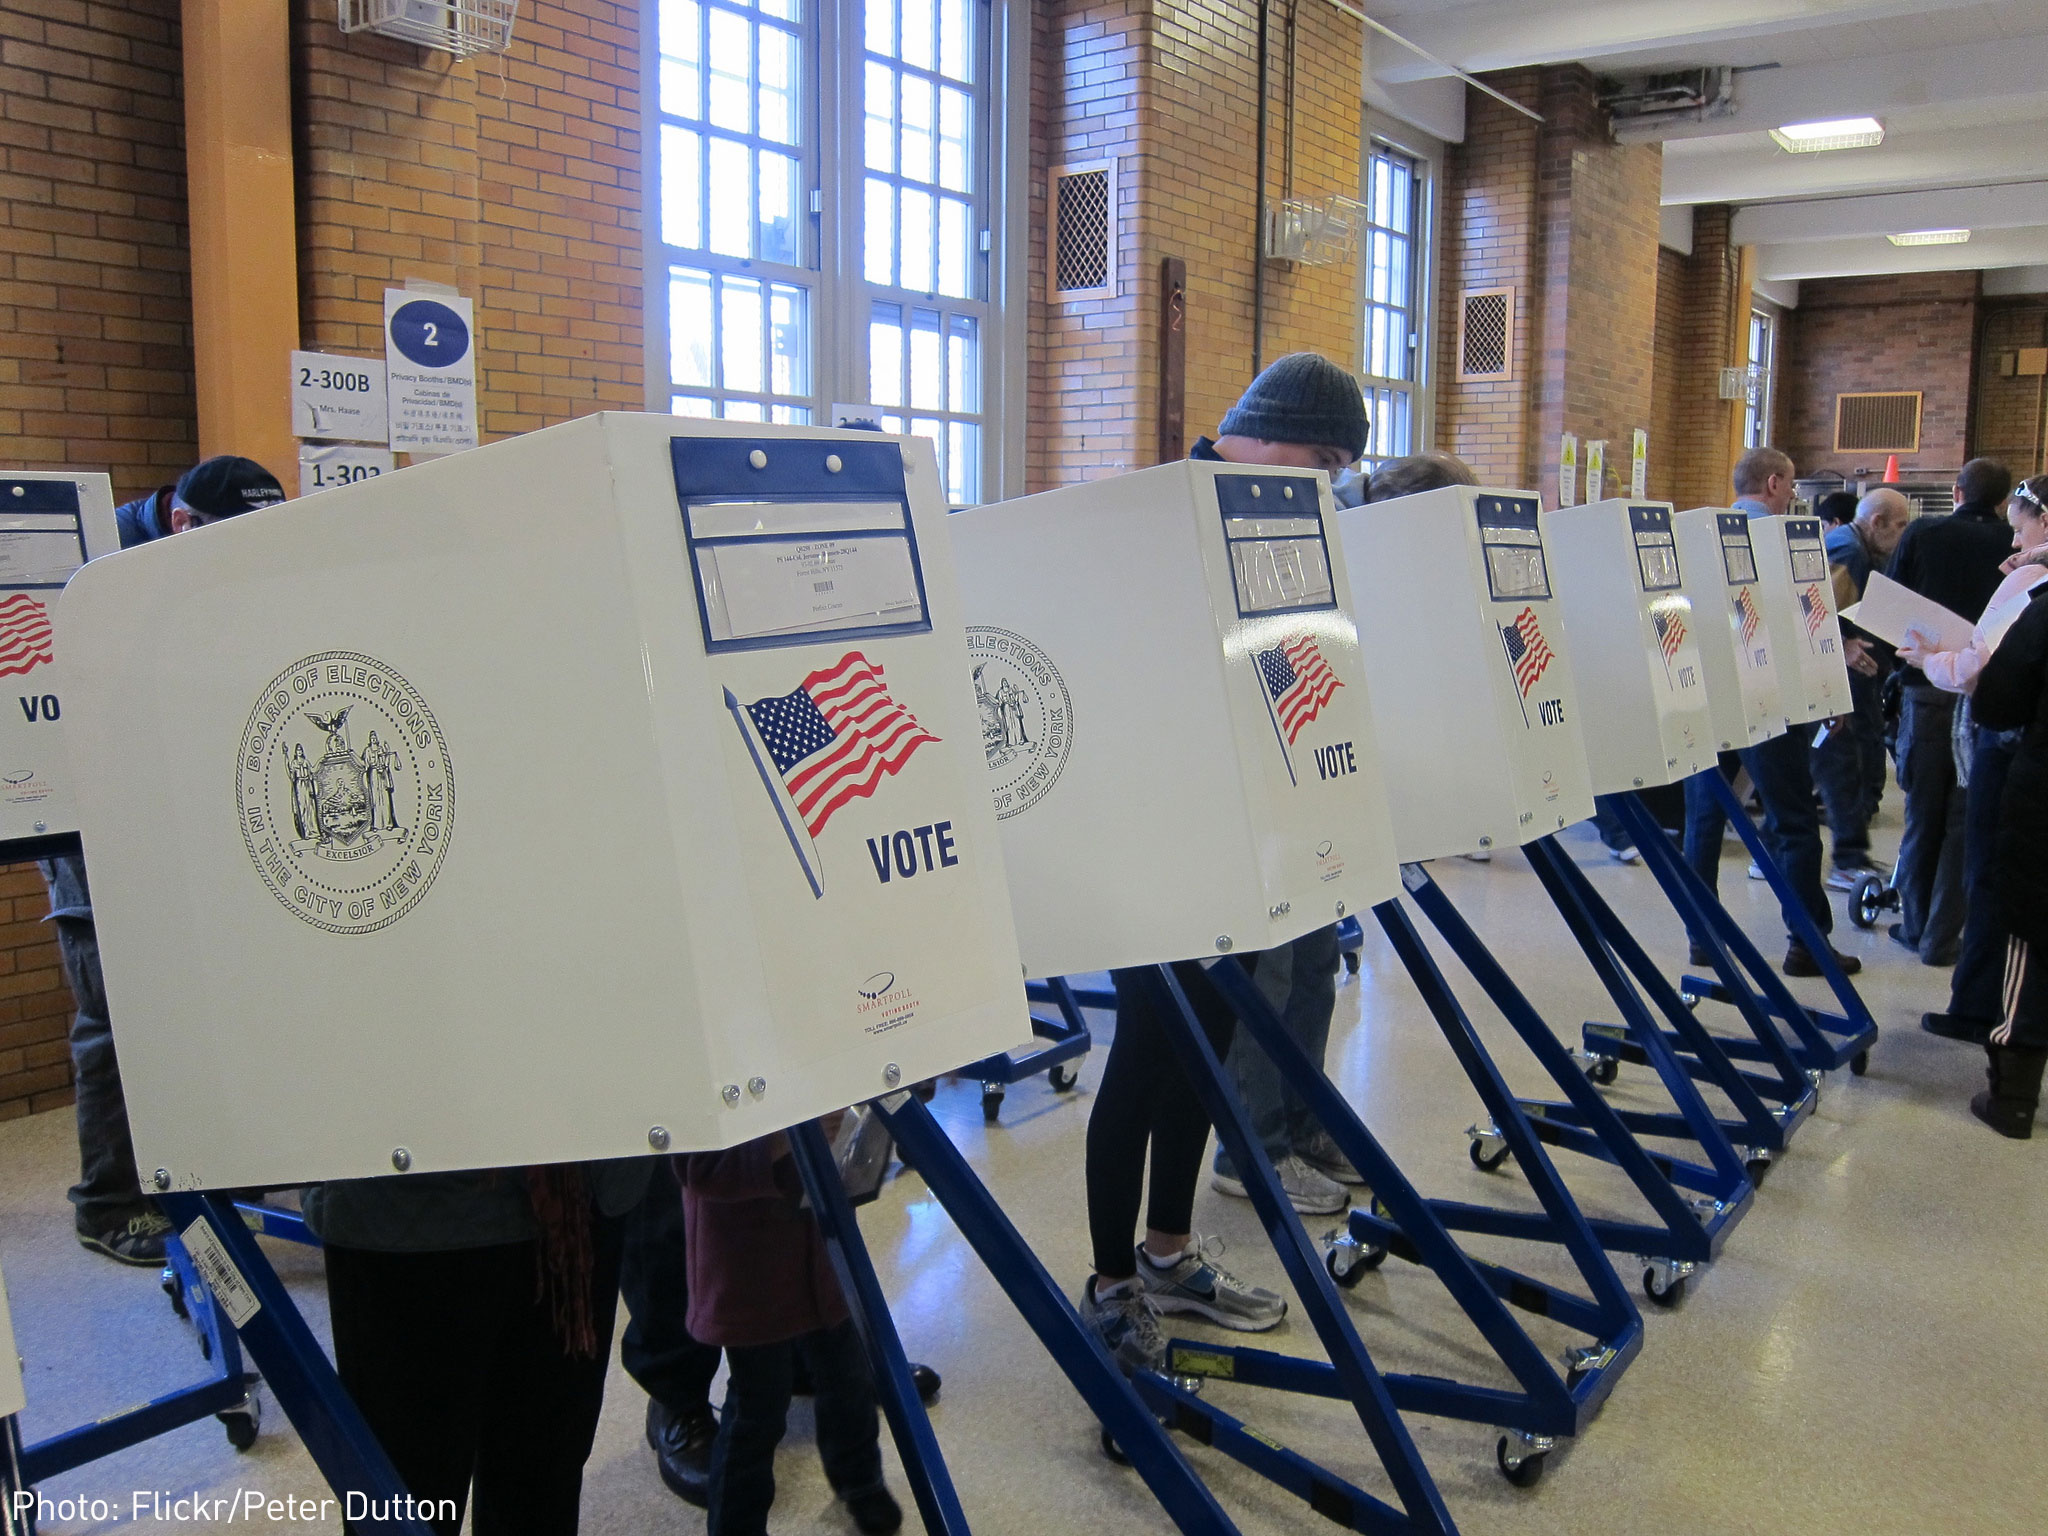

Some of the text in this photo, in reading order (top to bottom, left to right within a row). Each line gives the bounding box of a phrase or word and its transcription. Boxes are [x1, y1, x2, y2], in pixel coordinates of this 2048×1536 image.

[423, 322, 438, 346] 2
[300, 368, 370, 392] 2-300B
[392, 372, 417, 383] Privacy
[320, 404, 361, 416] Mrs. Haase
[1754, 648, 1768, 668] VOTE
[1819, 638, 1835, 654] VOTE
[1678, 666, 1696, 688] VOTE
[18, 694, 61, 724] VO
[247, 664, 432, 772] BOARD OF ELECTIONS
[1538, 698, 1564, 726] VOTE
[988, 756, 1010, 769] LSIOR
[1016, 762, 1050, 801] NEW
[1044, 707, 1064, 760] YORK
[1314, 741, 1358, 780] VOTE
[248, 783, 444, 920] IN THE CITY OF NEW YORK
[326, 844, 374, 860] EXCELSIOR
[866, 820, 959, 884] VOTE
[856, 988, 912, 1014] SMARTPOLL
